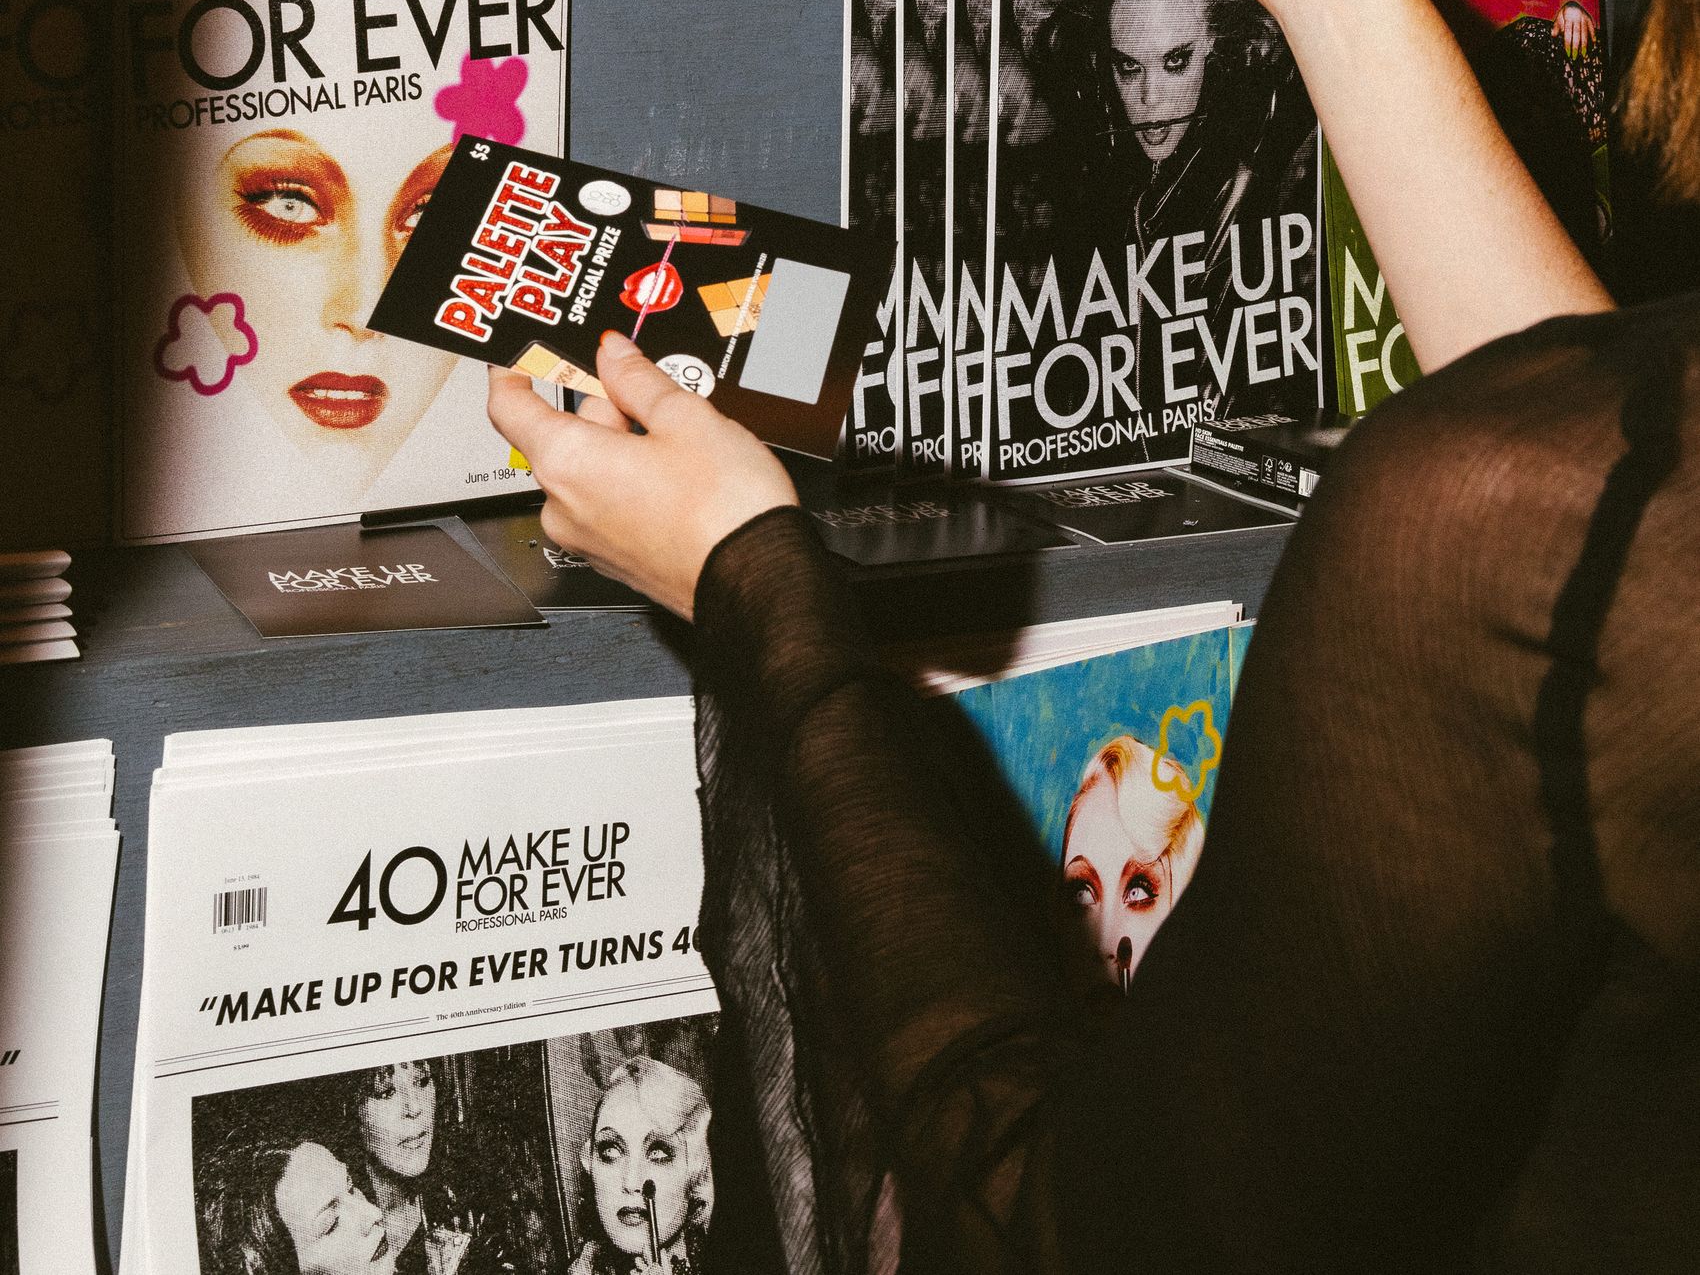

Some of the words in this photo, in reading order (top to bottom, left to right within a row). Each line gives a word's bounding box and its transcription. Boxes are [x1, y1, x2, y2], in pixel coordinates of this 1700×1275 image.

[139, 83, 346, 130] PROFESSIONAL
[353, 73, 423, 106] PARIS
[469, 142, 491, 161] $5
[434, 161, 561, 342] PALETTE
[504, 200, 597, 326] PLAY
[567, 264, 604, 325] SPECIAL
[592, 226, 622, 267] PRIZE
[994, 231, 1209, 353] MAKE
[1230, 213, 1313, 302] UP
[718, 353, 732, 378] SCRATCH
[726, 336, 737, 353] AWAY
[996, 334, 1140, 441] FOR
[1164, 297, 1319, 404] EVER
[1000, 413, 1158, 470] PROFESSIONAL
[1163, 399, 1215, 433] PARIS
[465, 472, 489, 484] June
[493, 468, 516, 480] 1984
[1108, 489, 1175, 503] EVER
[1113, 482, 1151, 492] UP
[268, 567, 375, 582] MAKE
[379, 564, 425, 575] UP
[271, 579, 347, 593] FOR
[351, 573, 440, 586] EVER
[457, 828, 571, 879] MAKE
[583, 821, 630, 863] UP
[326, 846, 448, 931] 40
[455, 874, 530, 920] FOR
[541, 861, 627, 909] EVER
[455, 912, 537, 933] PROFESSIONAL
[539, 906, 568, 921] PARIS
[333, 971, 383, 1007] UP
[390, 960, 460, 998] FOR
[468, 947, 549, 987] EVER
[557, 929, 664, 974] TURNS
[450, 1011, 464, 1019] 40th
[465, 1005, 503, 1017] Anniversary
[503, 1001, 527, 1011] Edition
